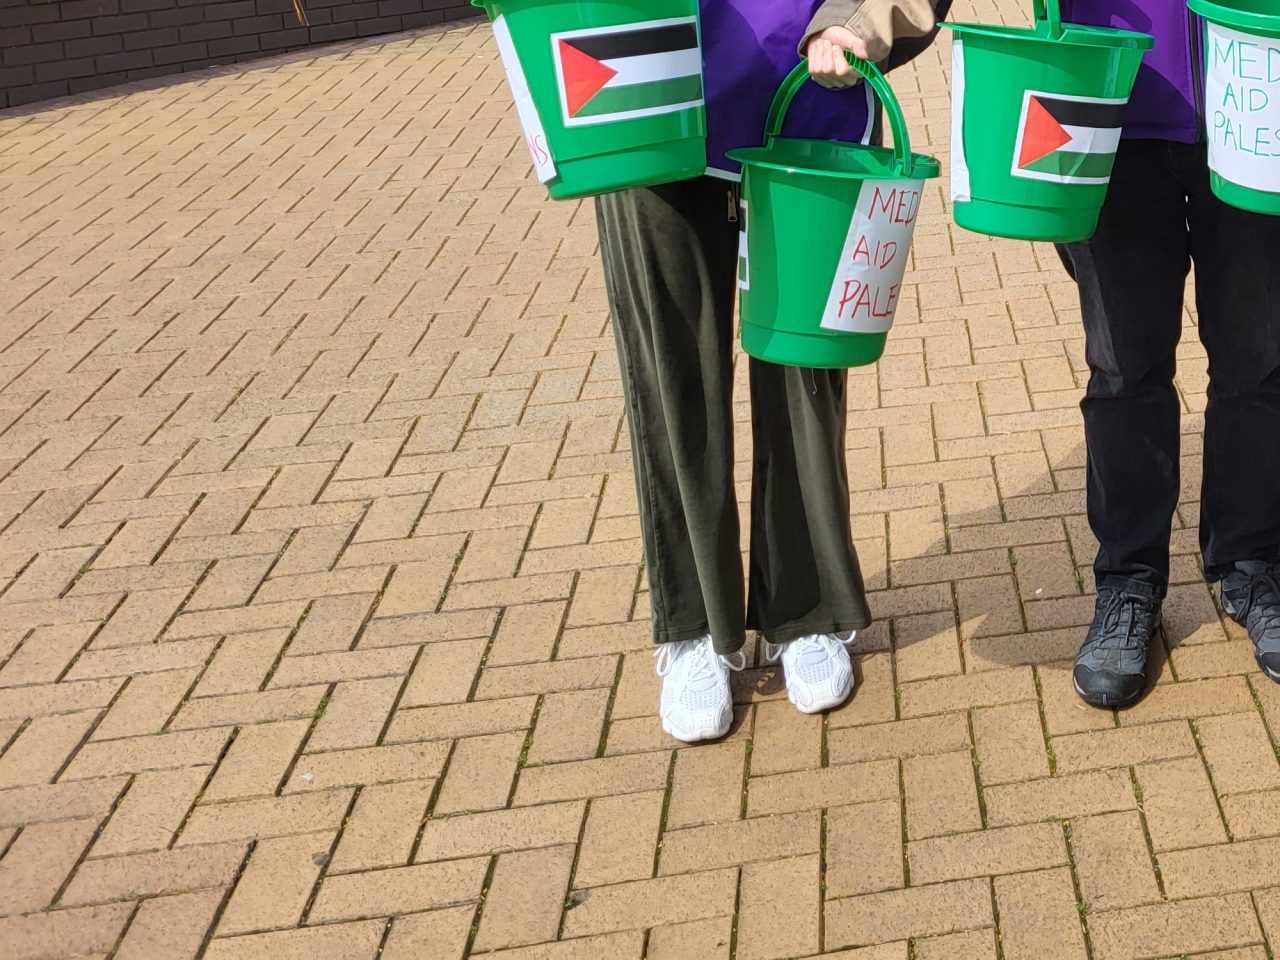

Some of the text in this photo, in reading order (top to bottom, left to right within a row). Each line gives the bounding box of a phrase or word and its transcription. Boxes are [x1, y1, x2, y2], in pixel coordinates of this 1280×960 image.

[1223, 82, 1269, 113] AID
[868, 186, 919, 228] MED
[852, 234, 898, 270] AID
[837, 279, 899, 319] PALE
